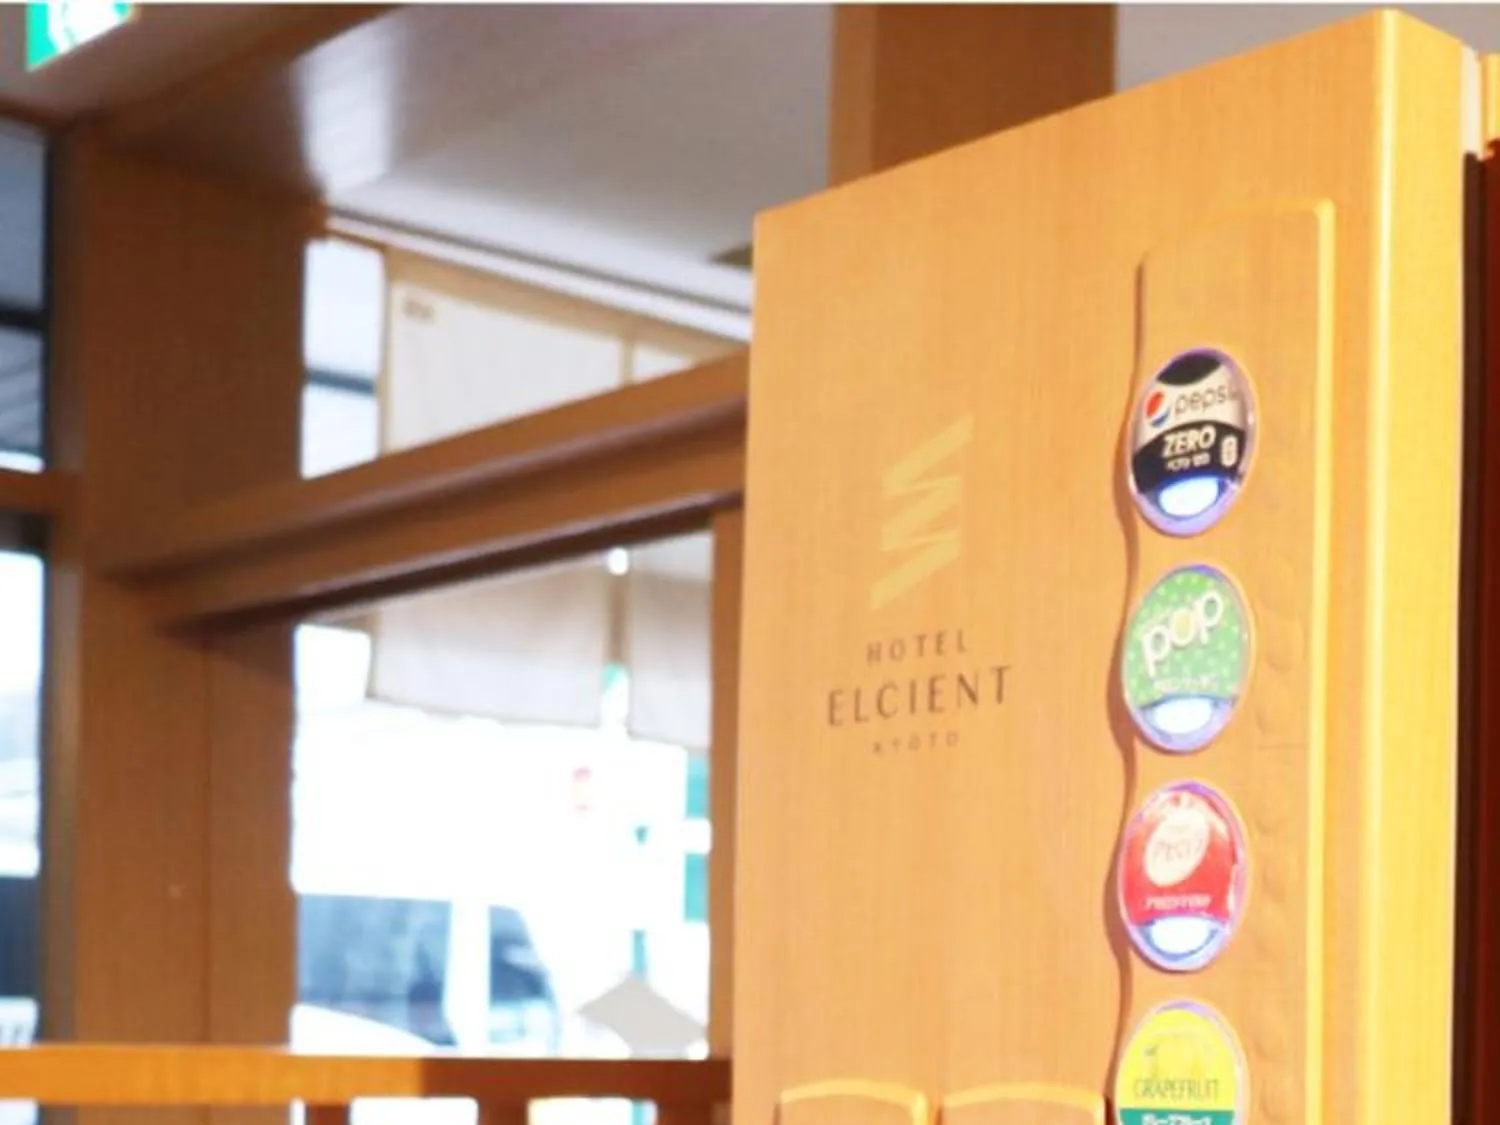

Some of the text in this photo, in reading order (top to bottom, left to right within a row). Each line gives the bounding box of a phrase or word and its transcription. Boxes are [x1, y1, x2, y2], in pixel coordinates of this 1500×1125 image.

[1162, 424, 1217, 457] ZERO
[866, 627, 968, 667] HOTEL
[827, 664, 1012, 727] ELCIENT
